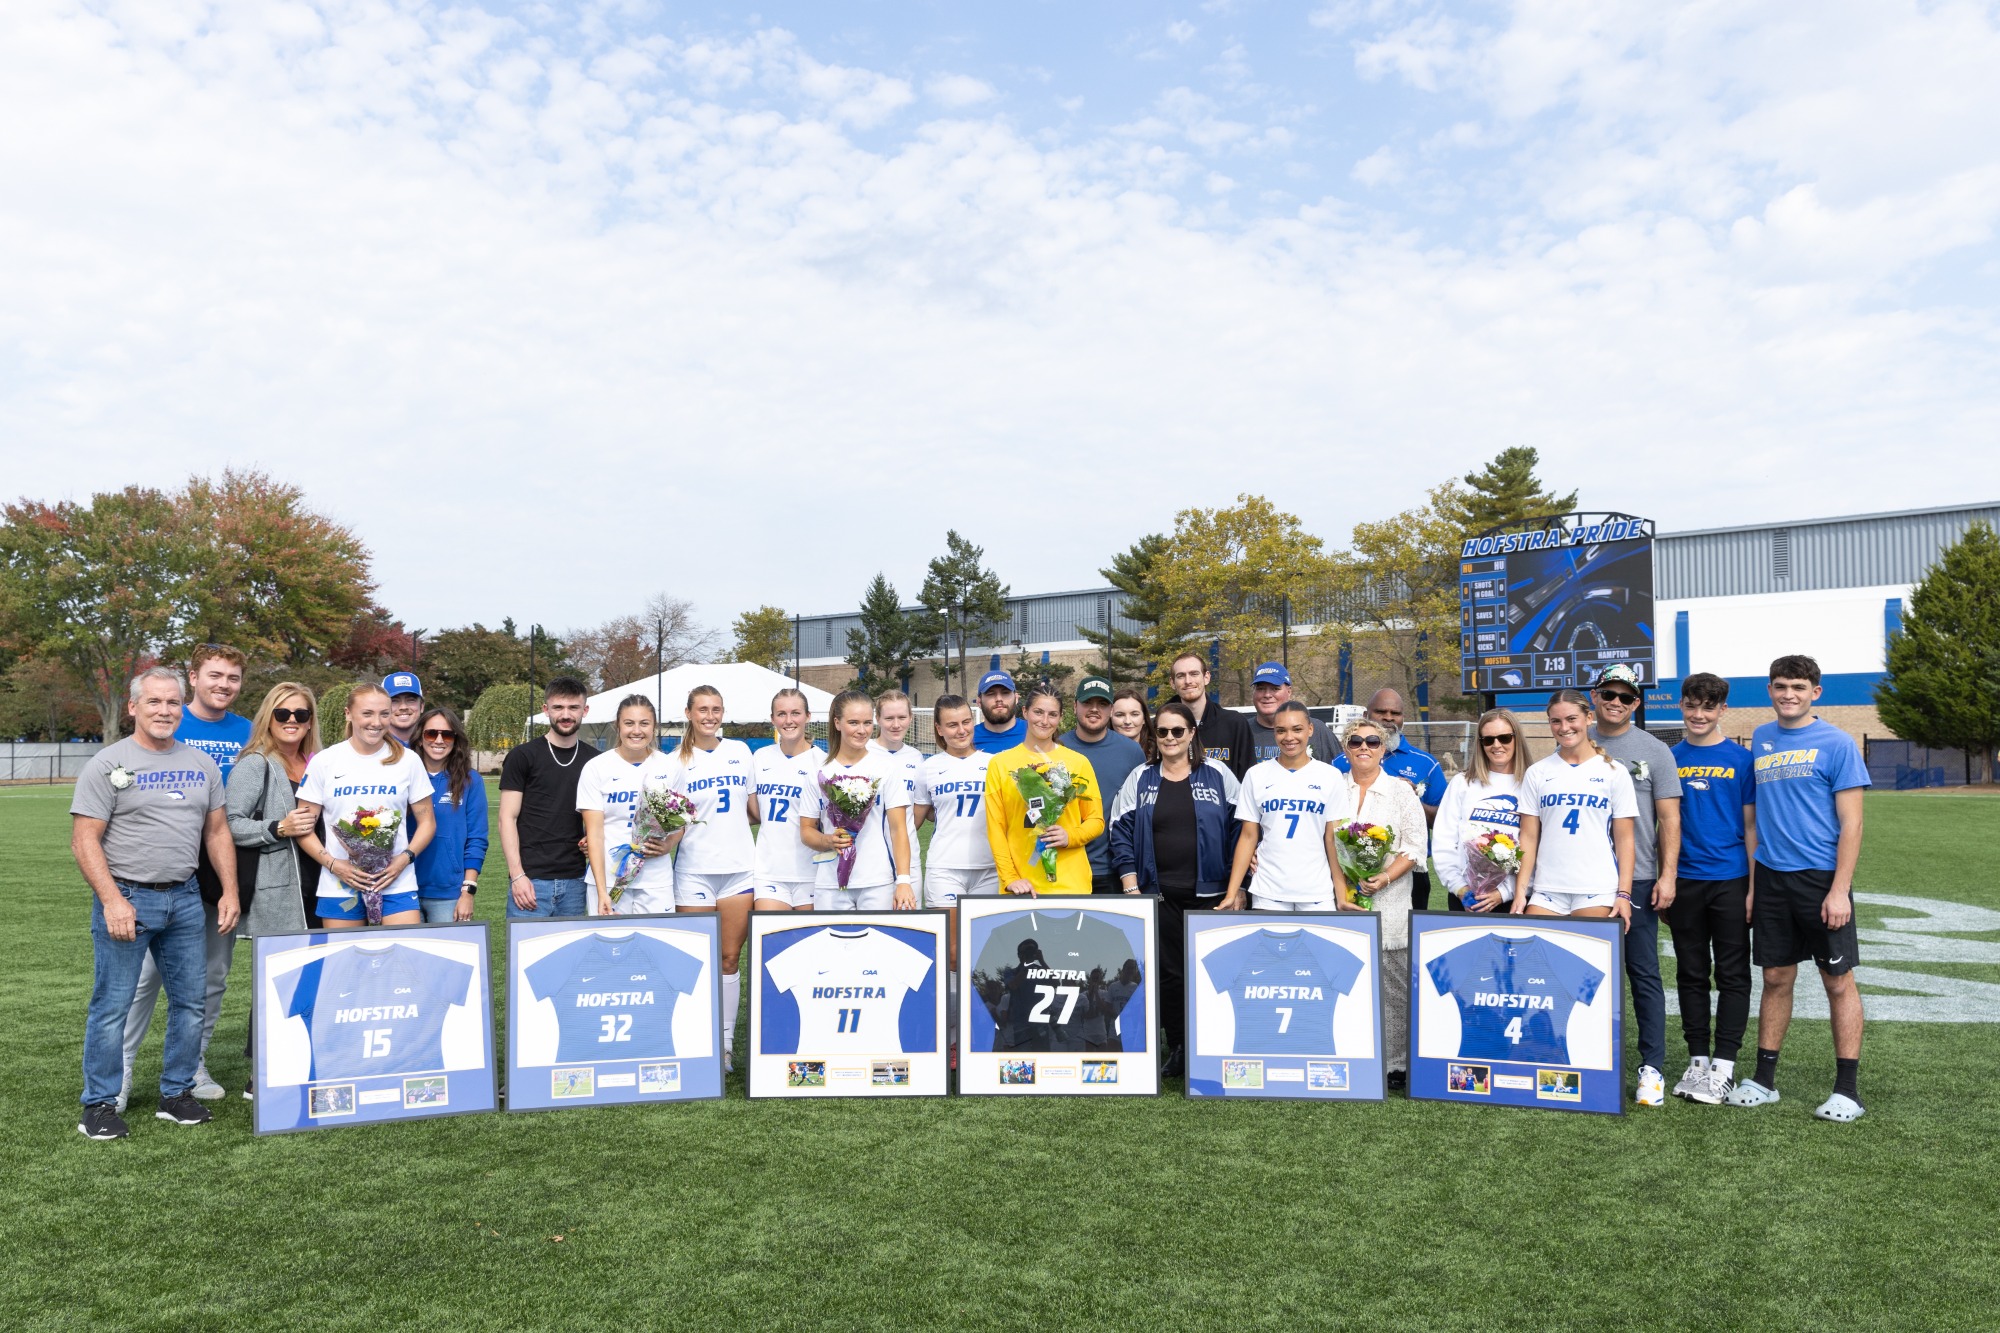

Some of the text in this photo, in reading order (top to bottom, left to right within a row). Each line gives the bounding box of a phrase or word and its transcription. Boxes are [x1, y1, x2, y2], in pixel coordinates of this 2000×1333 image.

[1462, 518, 1644, 558] HOFSTRA PRIDE
[1462, 564, 1472, 573] HU
[1494, 560, 1504, 570] HU
[1484, 656, 1510, 665] HOFSTRA
[1598, 650, 1629, 659] HAMPTON
[1543, 657, 1565, 671] 7:13
[184, 738, 242, 749] HOFSTRA
[137, 770, 205, 784] HOFSTRA
[1756, 764, 1813, 784] ASKETBALL
[140, 782, 204, 790] UNIVERSITY
[334, 785, 397, 797] HOFSTRA
[687, 776, 747, 793] HOFSTRA
[756, 783, 802, 798] HOFSTR
[935, 781, 986, 795] HOFST
[716, 789, 730, 813] 3
[956, 794, 981, 817] 17
[1261, 799, 1325, 814] HOFSTRA
[1540, 794, 1608, 809] HOFSTRA
[768, 798, 790, 822] 12
[1473, 809, 1520, 824] HOFSTRA
[1285, 814, 1299, 839] 7
[1562, 809, 1579, 834] 4
[1026, 969, 1087, 980] HOFSTRA
[576, 991, 654, 1008] HOFSTRA
[812, 987, 886, 999] HOFSTRA
[1244, 986, 1324, 1000] HOFSTRA
[1474, 992, 1554, 1010] HOFSTRA
[1028, 984, 1080, 1024] 27
[334, 1004, 418, 1024] HOFSTRA
[837, 1008, 861, 1033] 11
[1276, 1008, 1292, 1034] 7
[598, 1014, 633, 1043] 32
[1504, 1016, 1522, 1044] 4
[362, 1028, 392, 1058] 15
